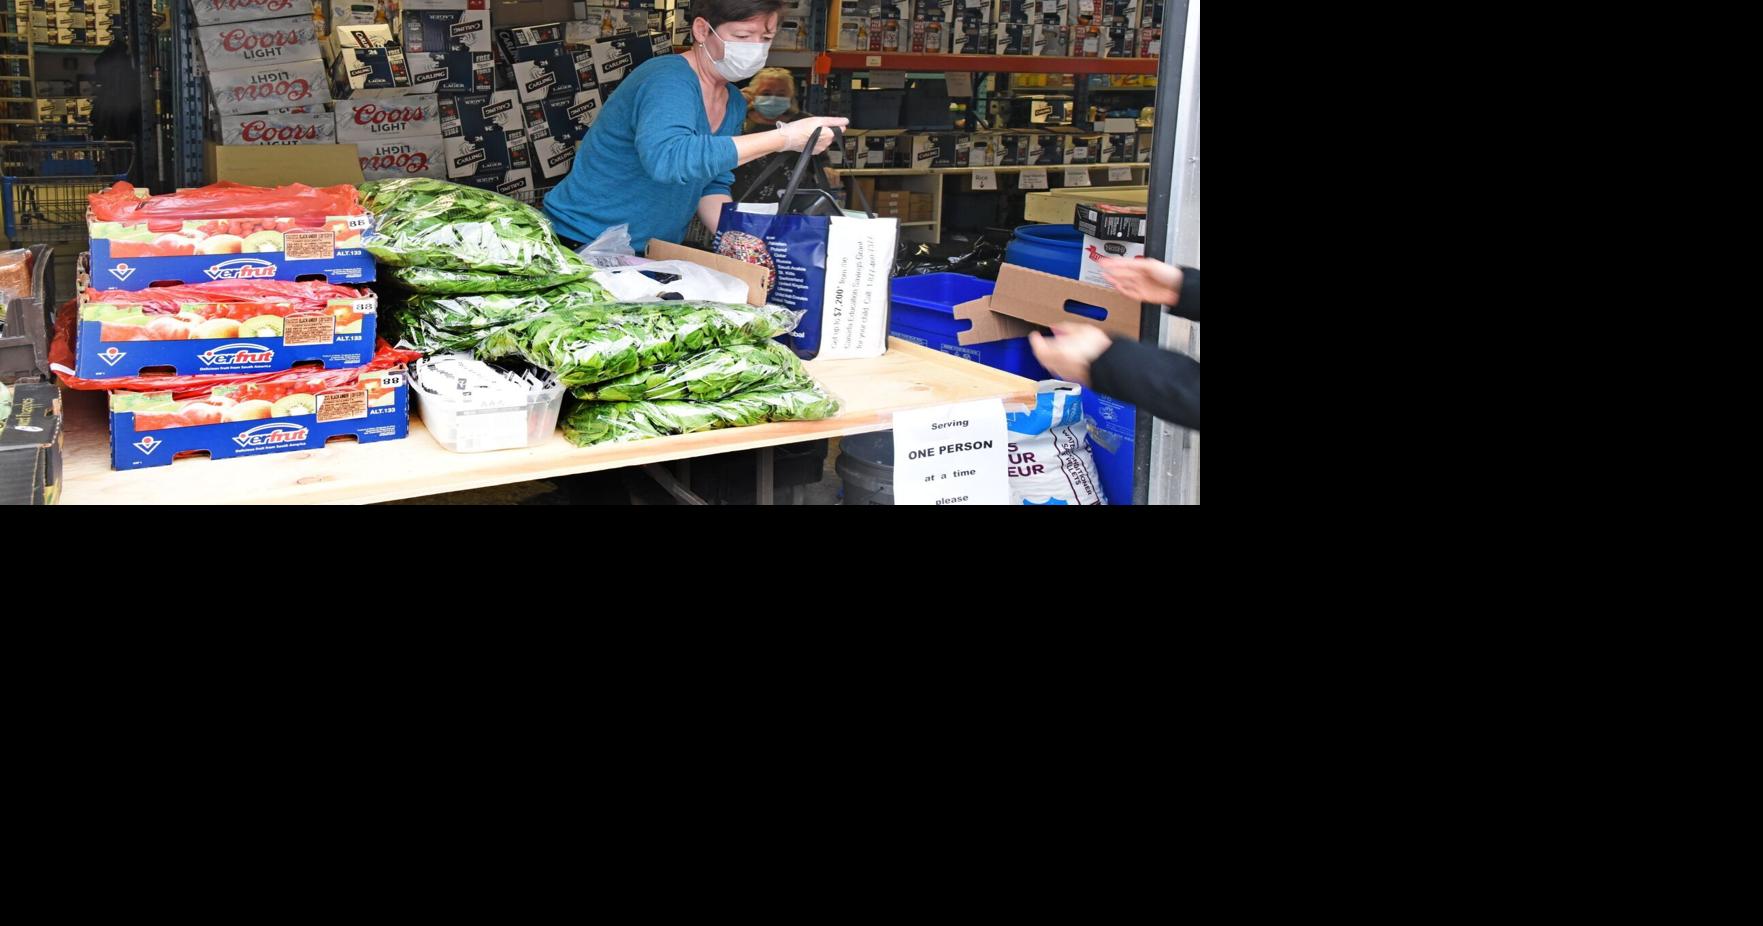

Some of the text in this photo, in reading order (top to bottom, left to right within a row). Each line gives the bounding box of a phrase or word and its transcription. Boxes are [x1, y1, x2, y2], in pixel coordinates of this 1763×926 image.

[220, 28, 299, 52] Coors
[243, 47, 282, 59] LIGHT
[251, 71, 289, 84] LIGHT
[416, 71, 446, 81] CARLING
[528, 76, 553, 90] CARLING
[233, 78, 312, 101] Coors
[352, 104, 424, 125] Coors
[240, 120, 317, 142] Coors
[371, 122, 407, 133] LIGHT
[375, 145, 411, 156] LIGHT
[358, 152, 429, 174] Coors
[456, 151, 483, 165] CARLING
[383, 377, 400, 385] 88
[370, 407, 396, 415] ALT.133
[931, 419, 969, 430] Serving
[908, 440, 993, 460] ONE PERSON
[953, 469, 976, 478] time
[935, 495, 969, 505] please
